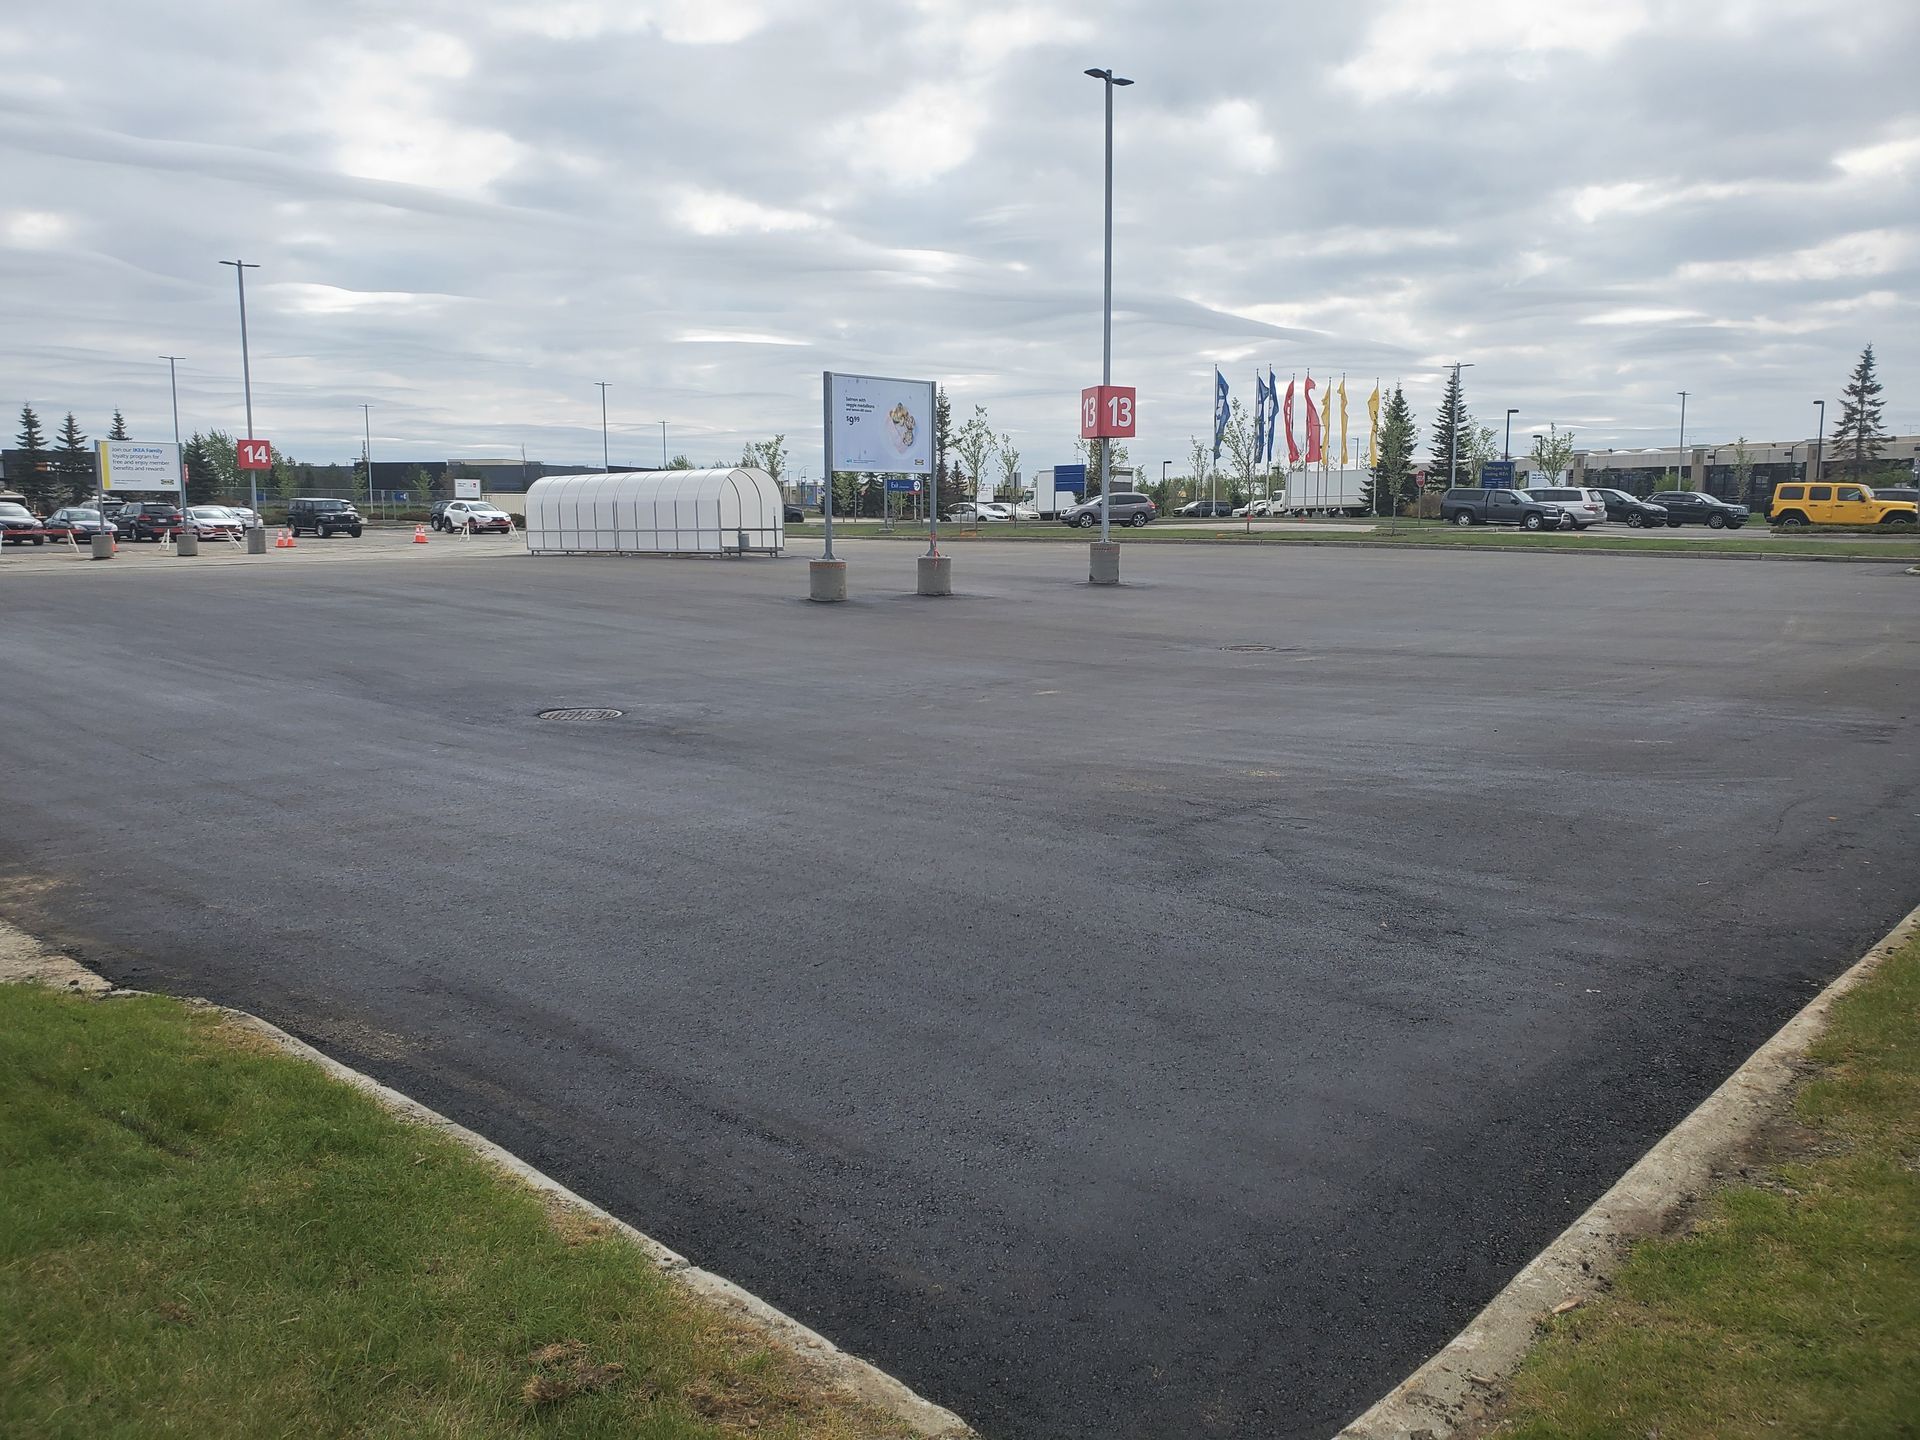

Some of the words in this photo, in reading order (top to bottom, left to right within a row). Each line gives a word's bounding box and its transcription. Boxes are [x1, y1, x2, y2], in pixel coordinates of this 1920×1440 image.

[1084, 397, 1096, 428] 13
[1108, 396, 1132, 427] 13
[243, 445, 268, 463] 14
